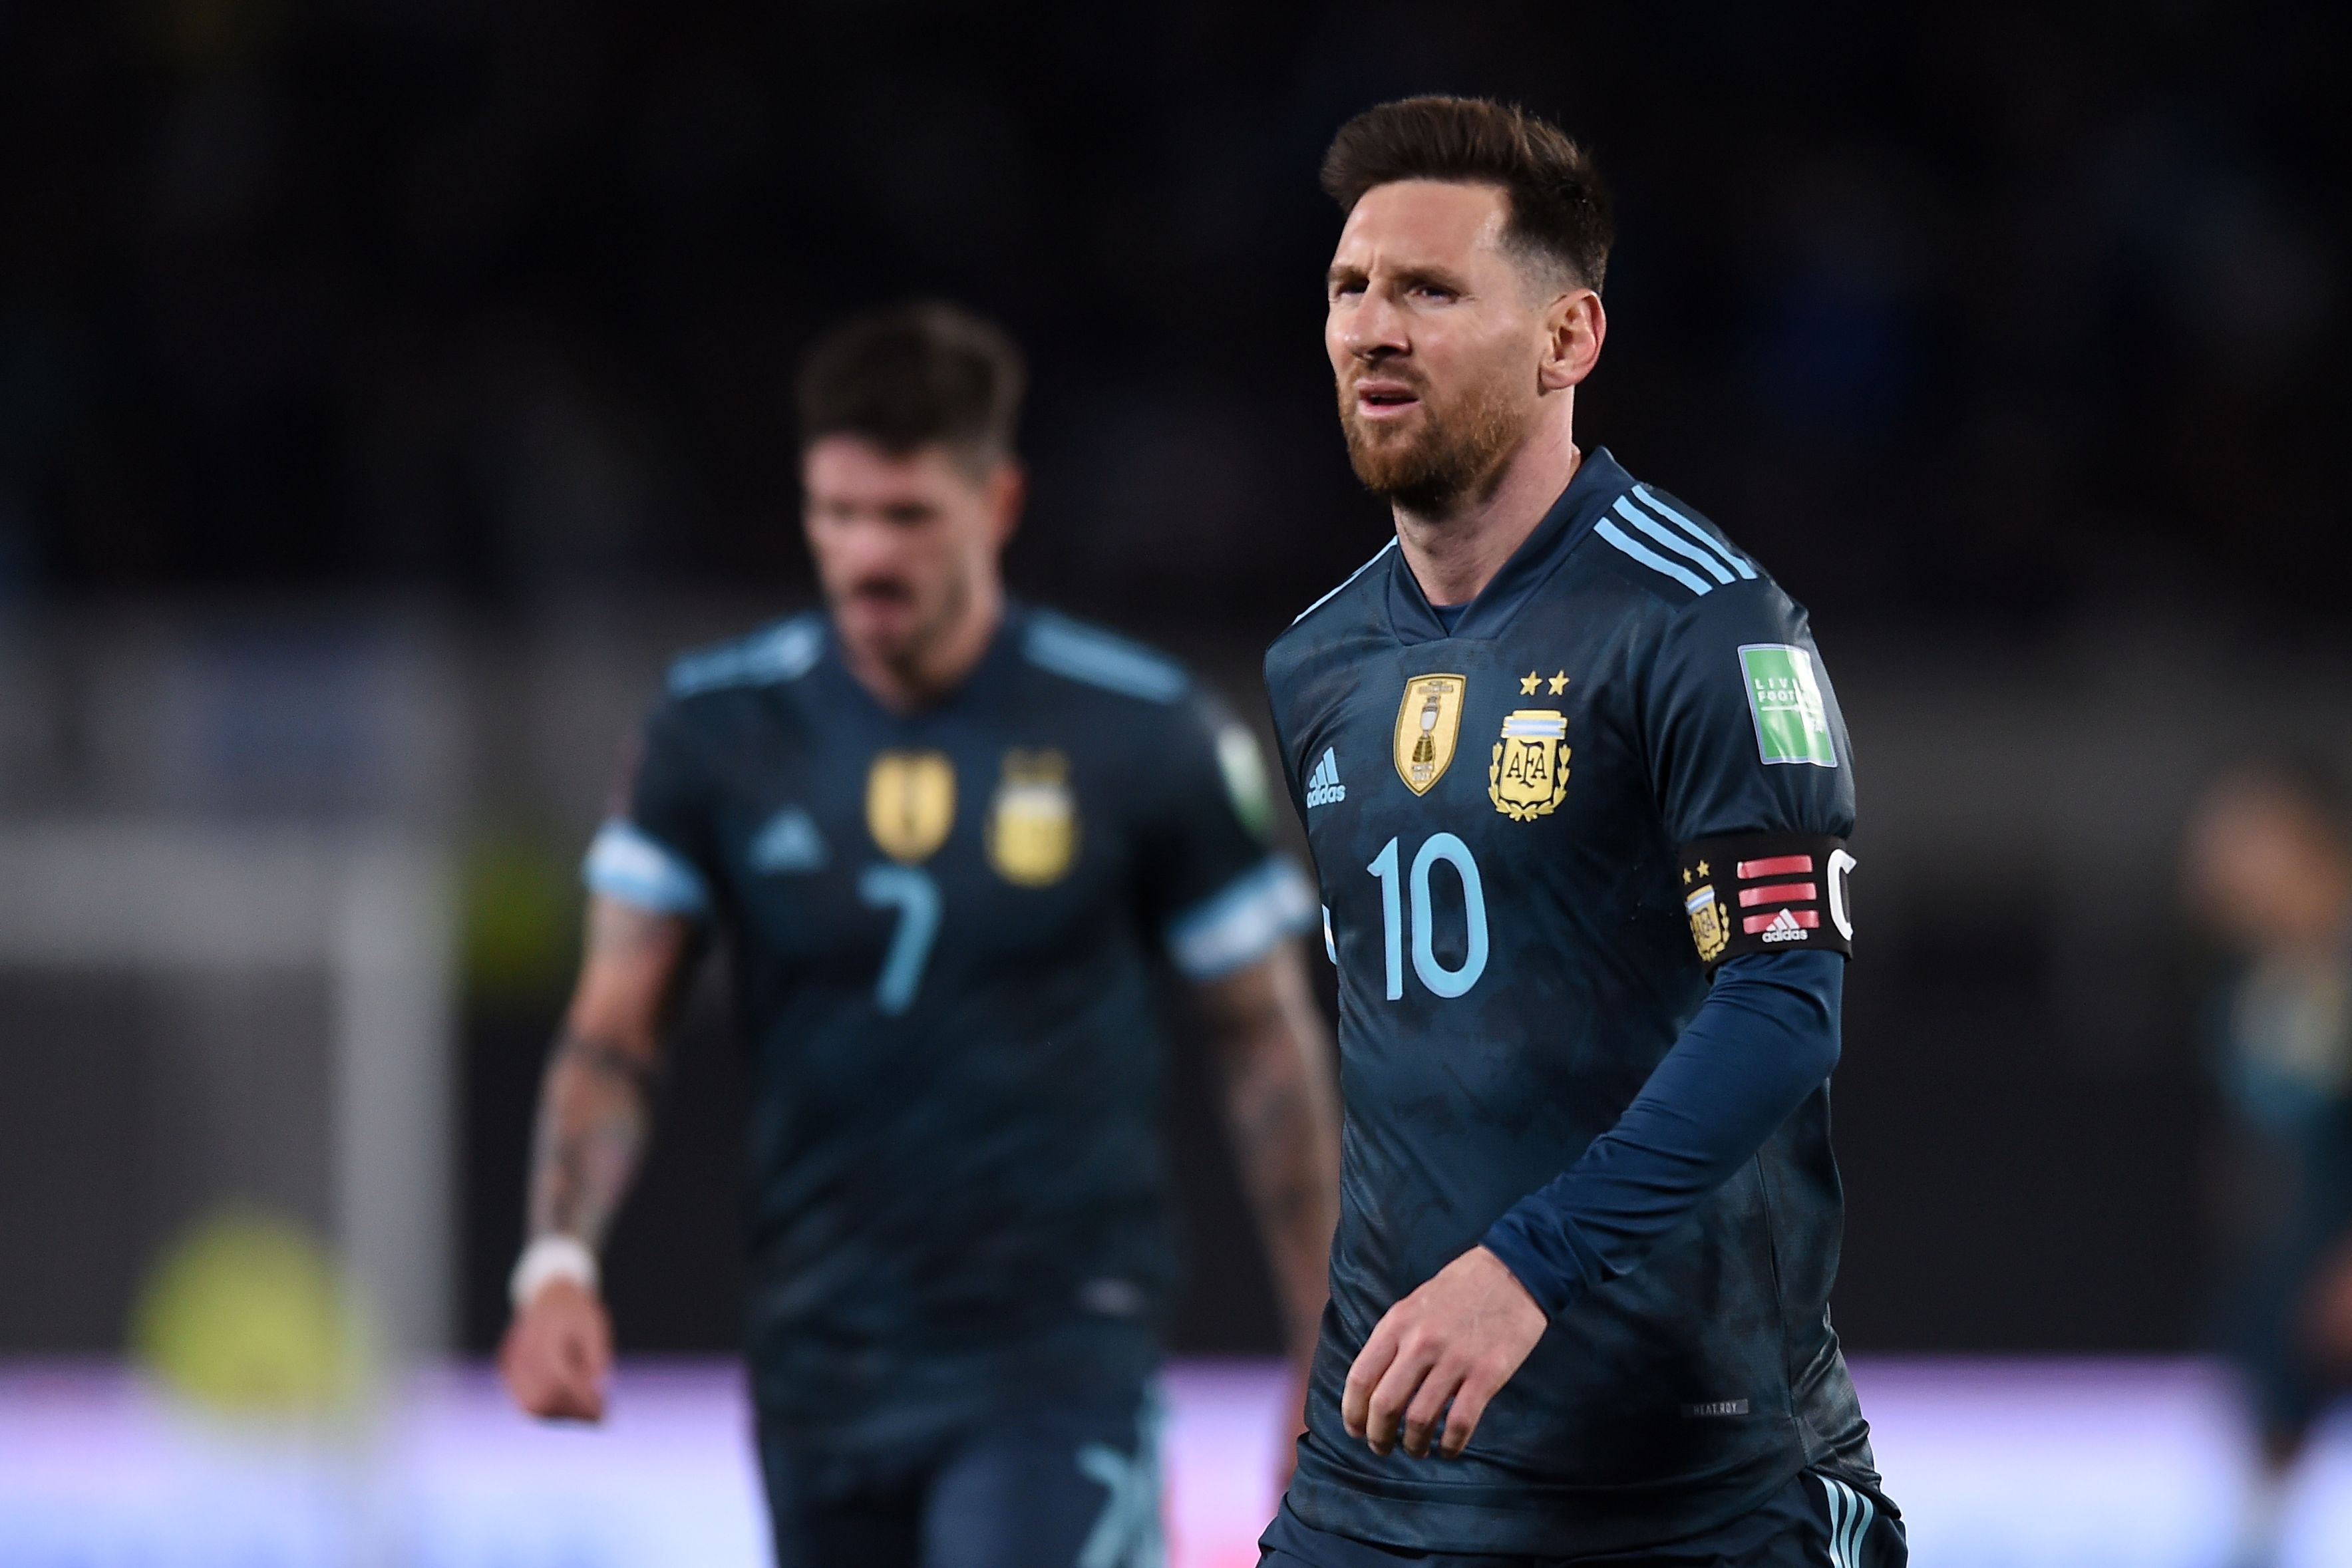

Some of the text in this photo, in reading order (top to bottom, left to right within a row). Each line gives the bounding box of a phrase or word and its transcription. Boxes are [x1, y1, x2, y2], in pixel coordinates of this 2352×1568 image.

[1506, 740, 1547, 788] AFA
[1307, 785, 1345, 808] adidas
[858, 865, 942, 1017] 7
[1367, 833, 1488, 1001] 10
[1762, 929, 1808, 943] adidas
